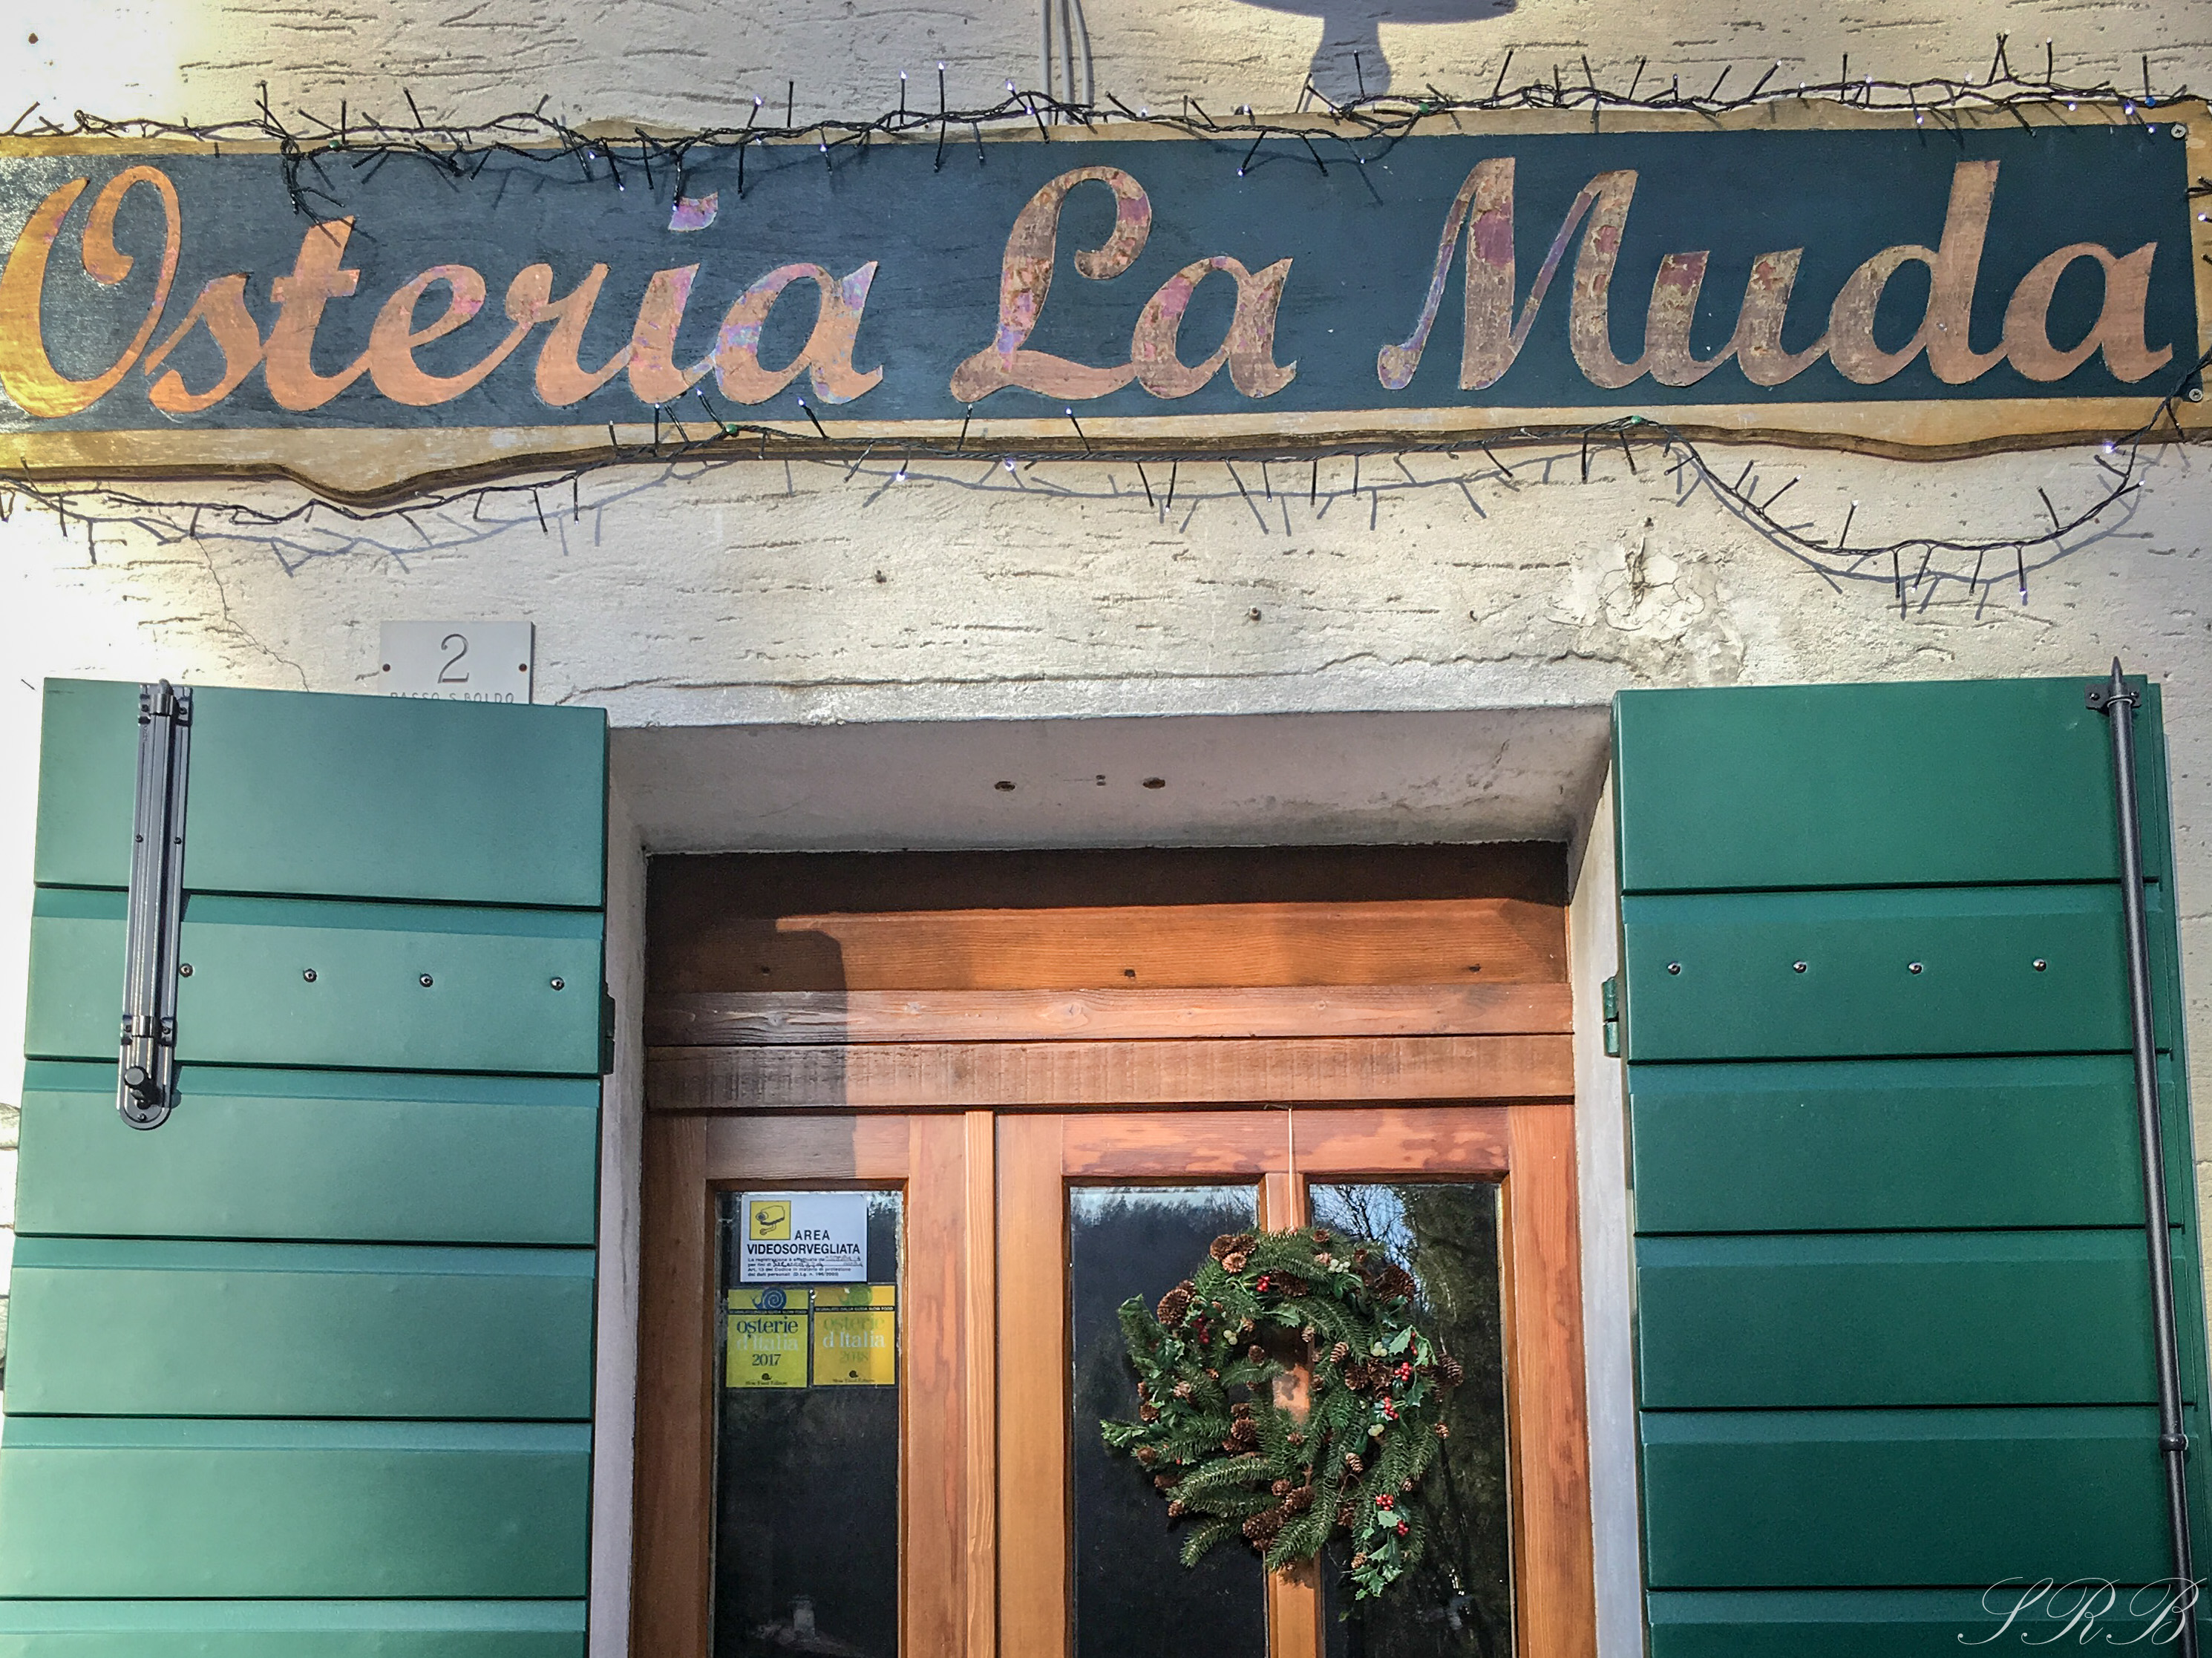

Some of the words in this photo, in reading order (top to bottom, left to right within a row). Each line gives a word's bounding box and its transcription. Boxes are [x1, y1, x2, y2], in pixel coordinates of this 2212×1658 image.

[0, 166, 883, 418] Osteria
[950, 166, 1298, 402] La
[1378, 157, 2173, 390] Muda
[438, 634, 470, 684] 2
[794, 1230, 830, 1241] AREA
[747, 1243, 860, 1254] VIDEOSORVEGLIATA
[736, 1316, 799, 1334] osterie
[752, 1354, 782, 1366] 2017
